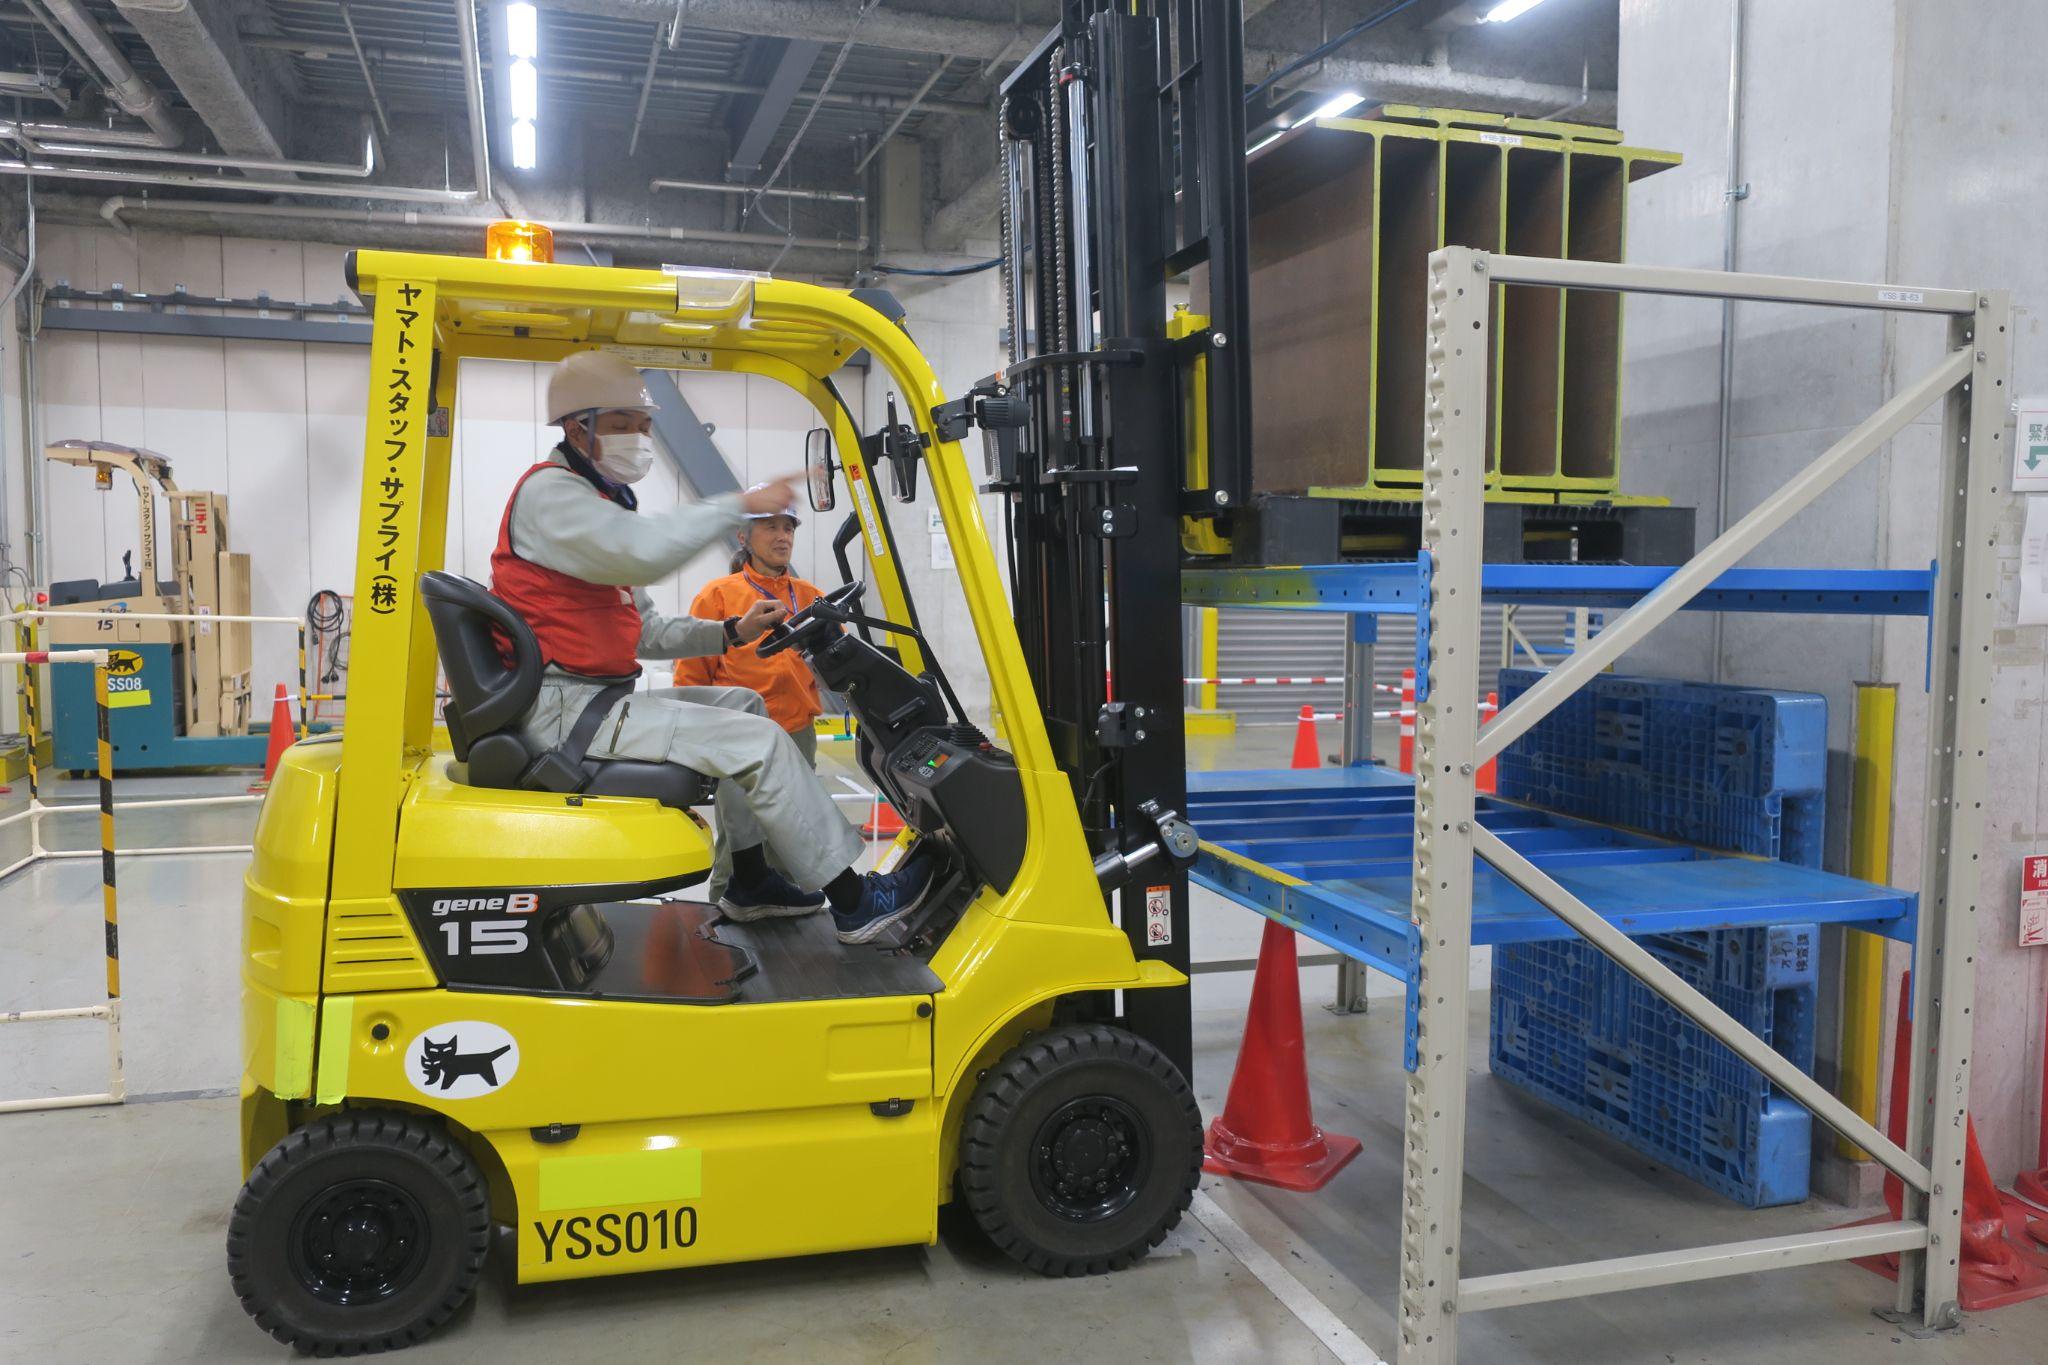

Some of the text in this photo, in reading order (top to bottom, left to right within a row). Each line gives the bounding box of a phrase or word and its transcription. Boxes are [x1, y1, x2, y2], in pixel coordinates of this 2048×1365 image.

[97, 620, 114, 631] 15
[439, 919, 529, 956] 15
[534, 1206, 698, 1263] YSS010
